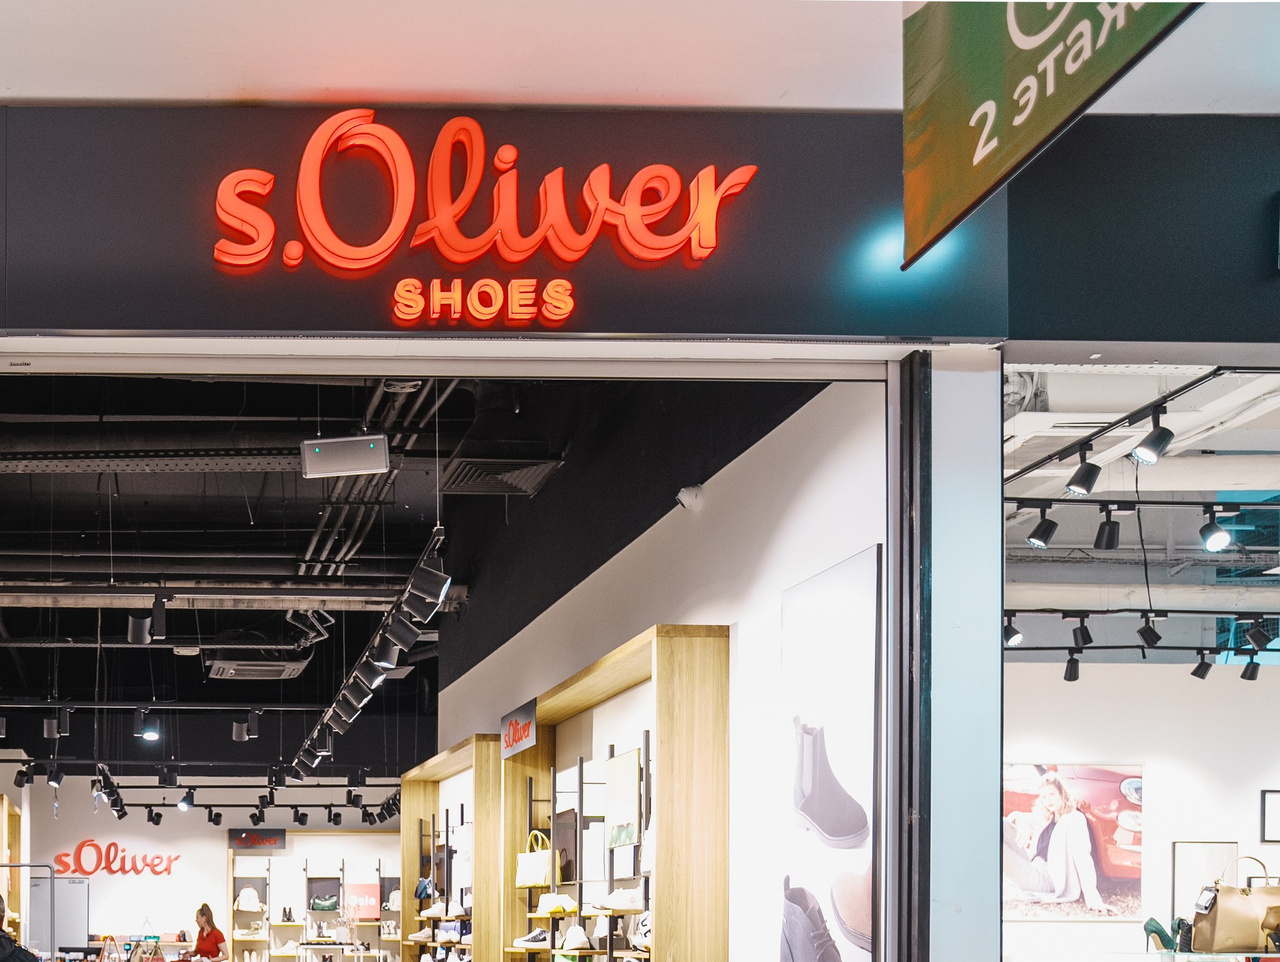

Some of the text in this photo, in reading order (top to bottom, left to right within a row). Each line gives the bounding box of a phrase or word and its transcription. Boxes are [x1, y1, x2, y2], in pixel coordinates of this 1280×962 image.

[968, 99, 999, 167] 2
[213, 108, 758, 271] s.Oliver
[393, 277, 575, 322] SHOES
[53, 838, 182, 877] s.Oliver
